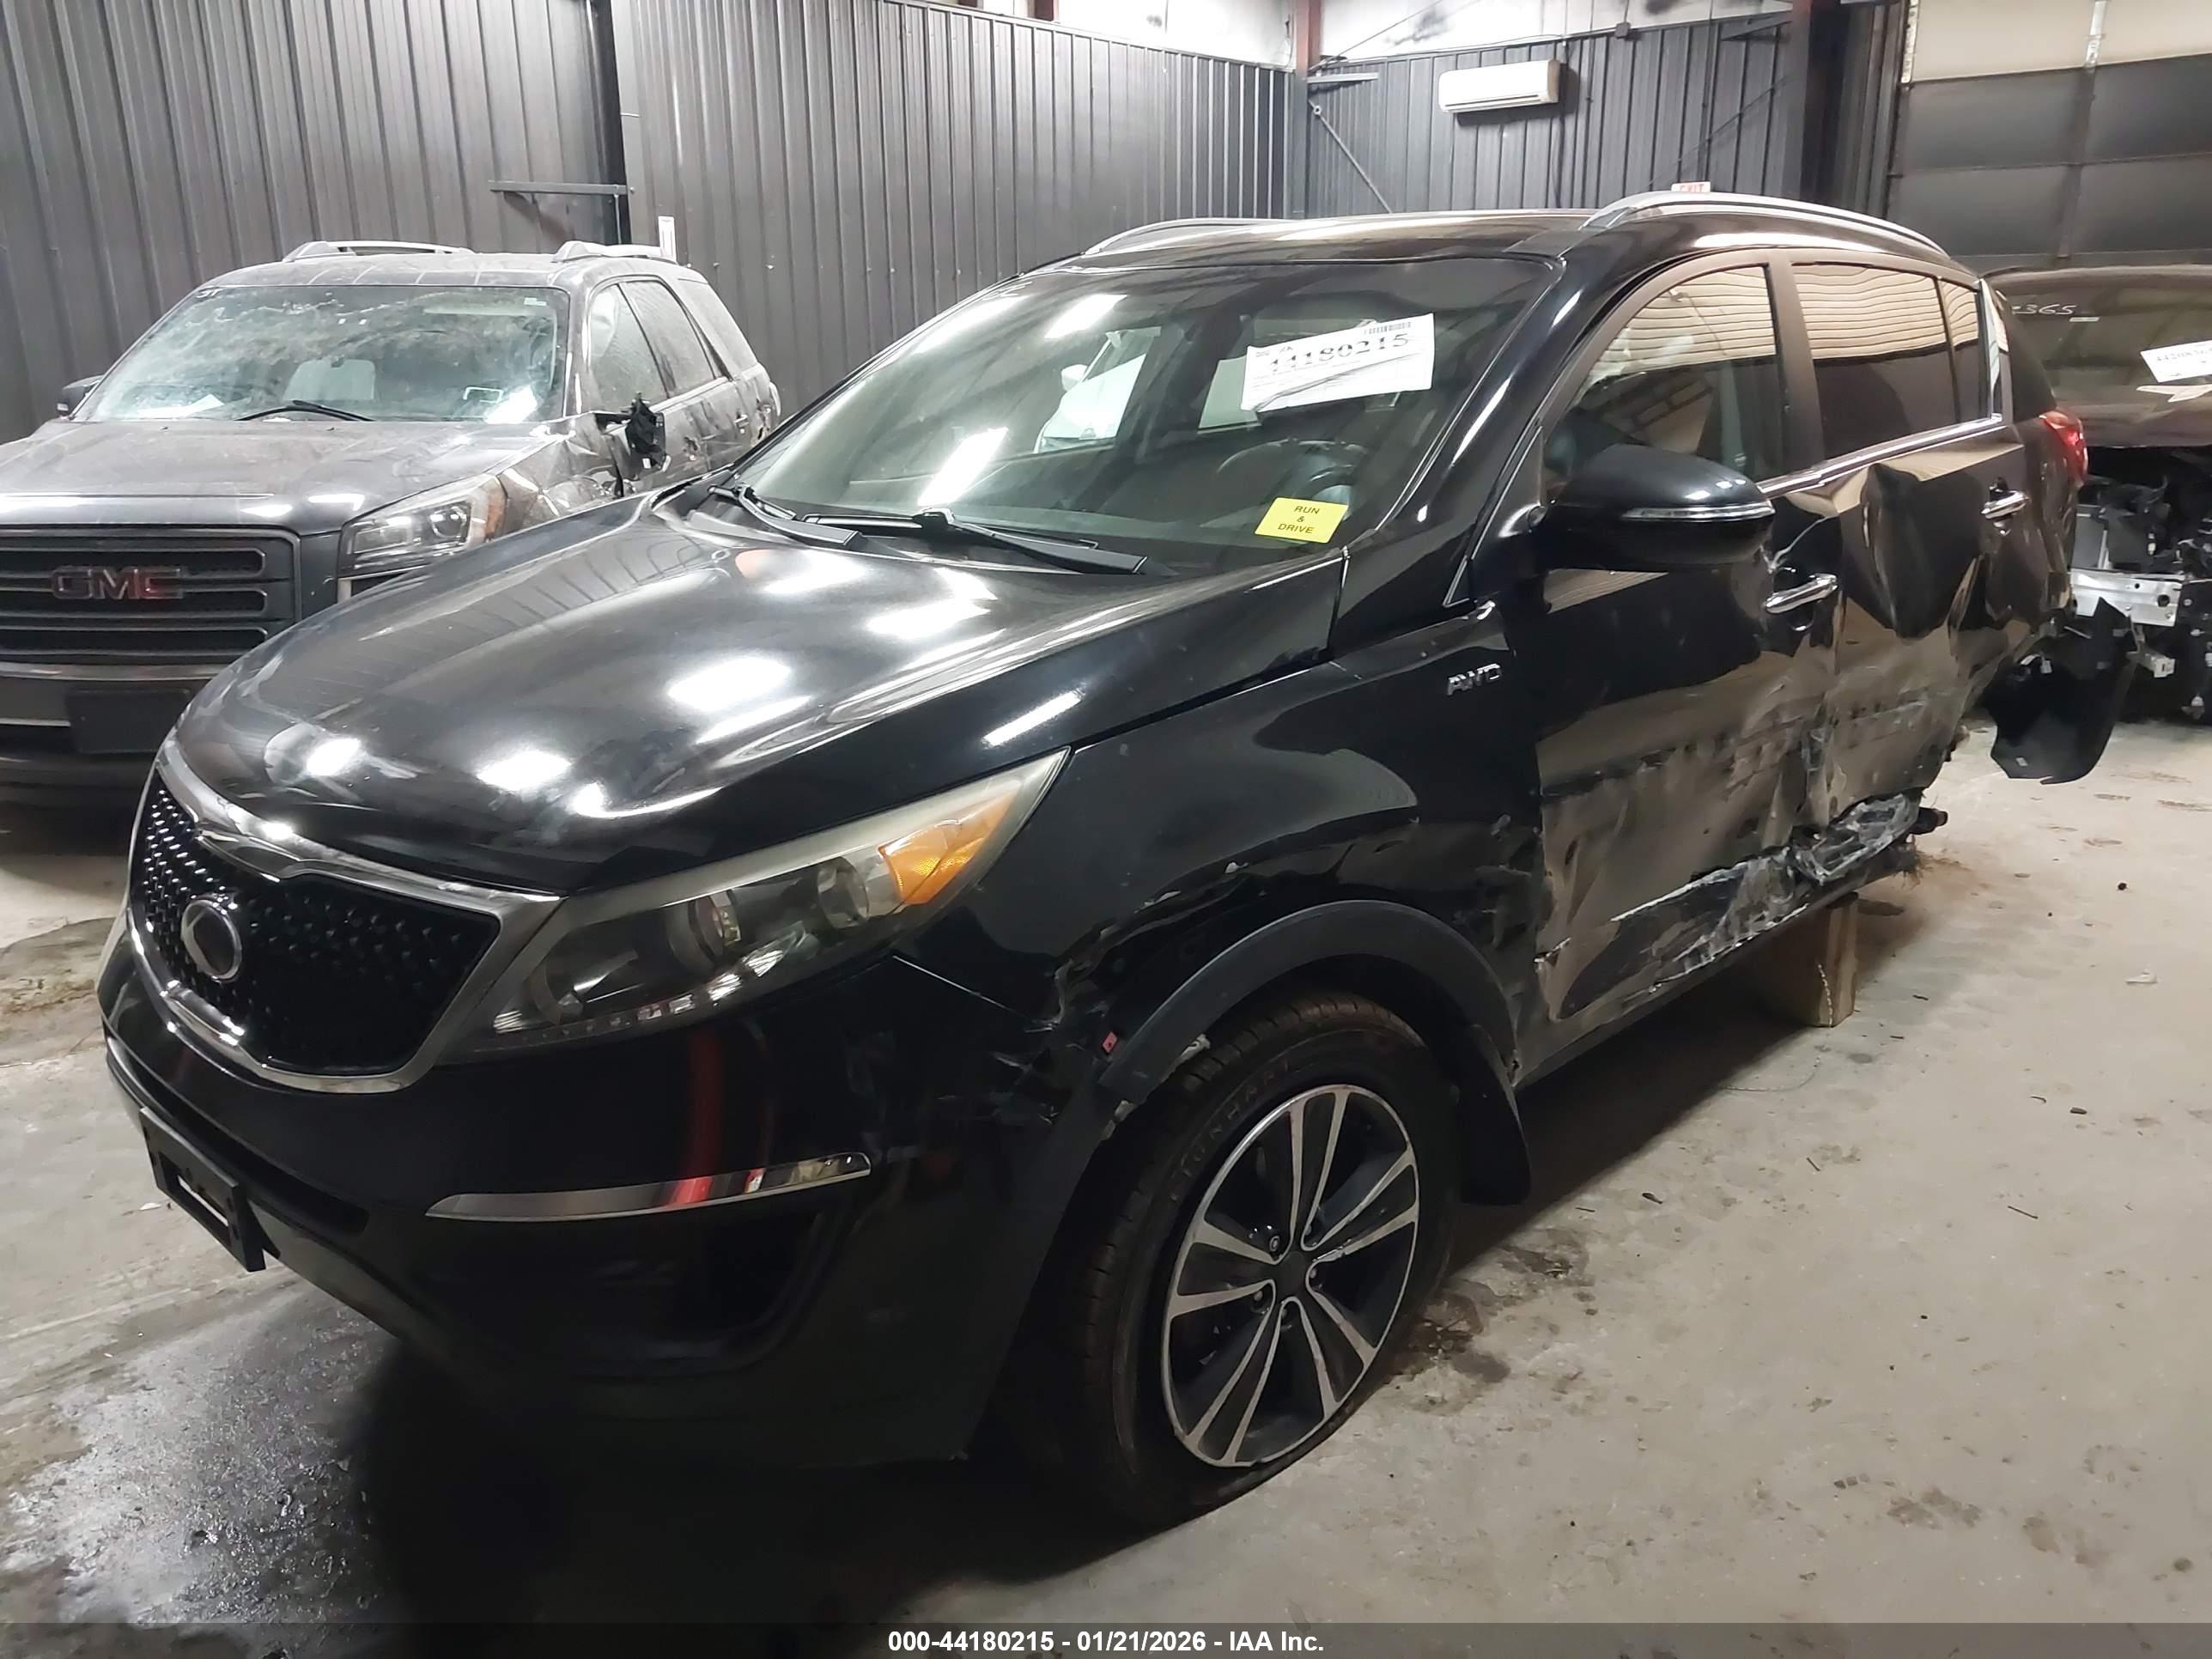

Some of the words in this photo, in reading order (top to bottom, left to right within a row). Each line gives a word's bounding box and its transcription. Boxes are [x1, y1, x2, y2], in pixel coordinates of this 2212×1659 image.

[1294, 505, 1320, 514] RUN
[1278, 523, 1315, 534] DRIVE
[52, 566, 187, 599] GMC
